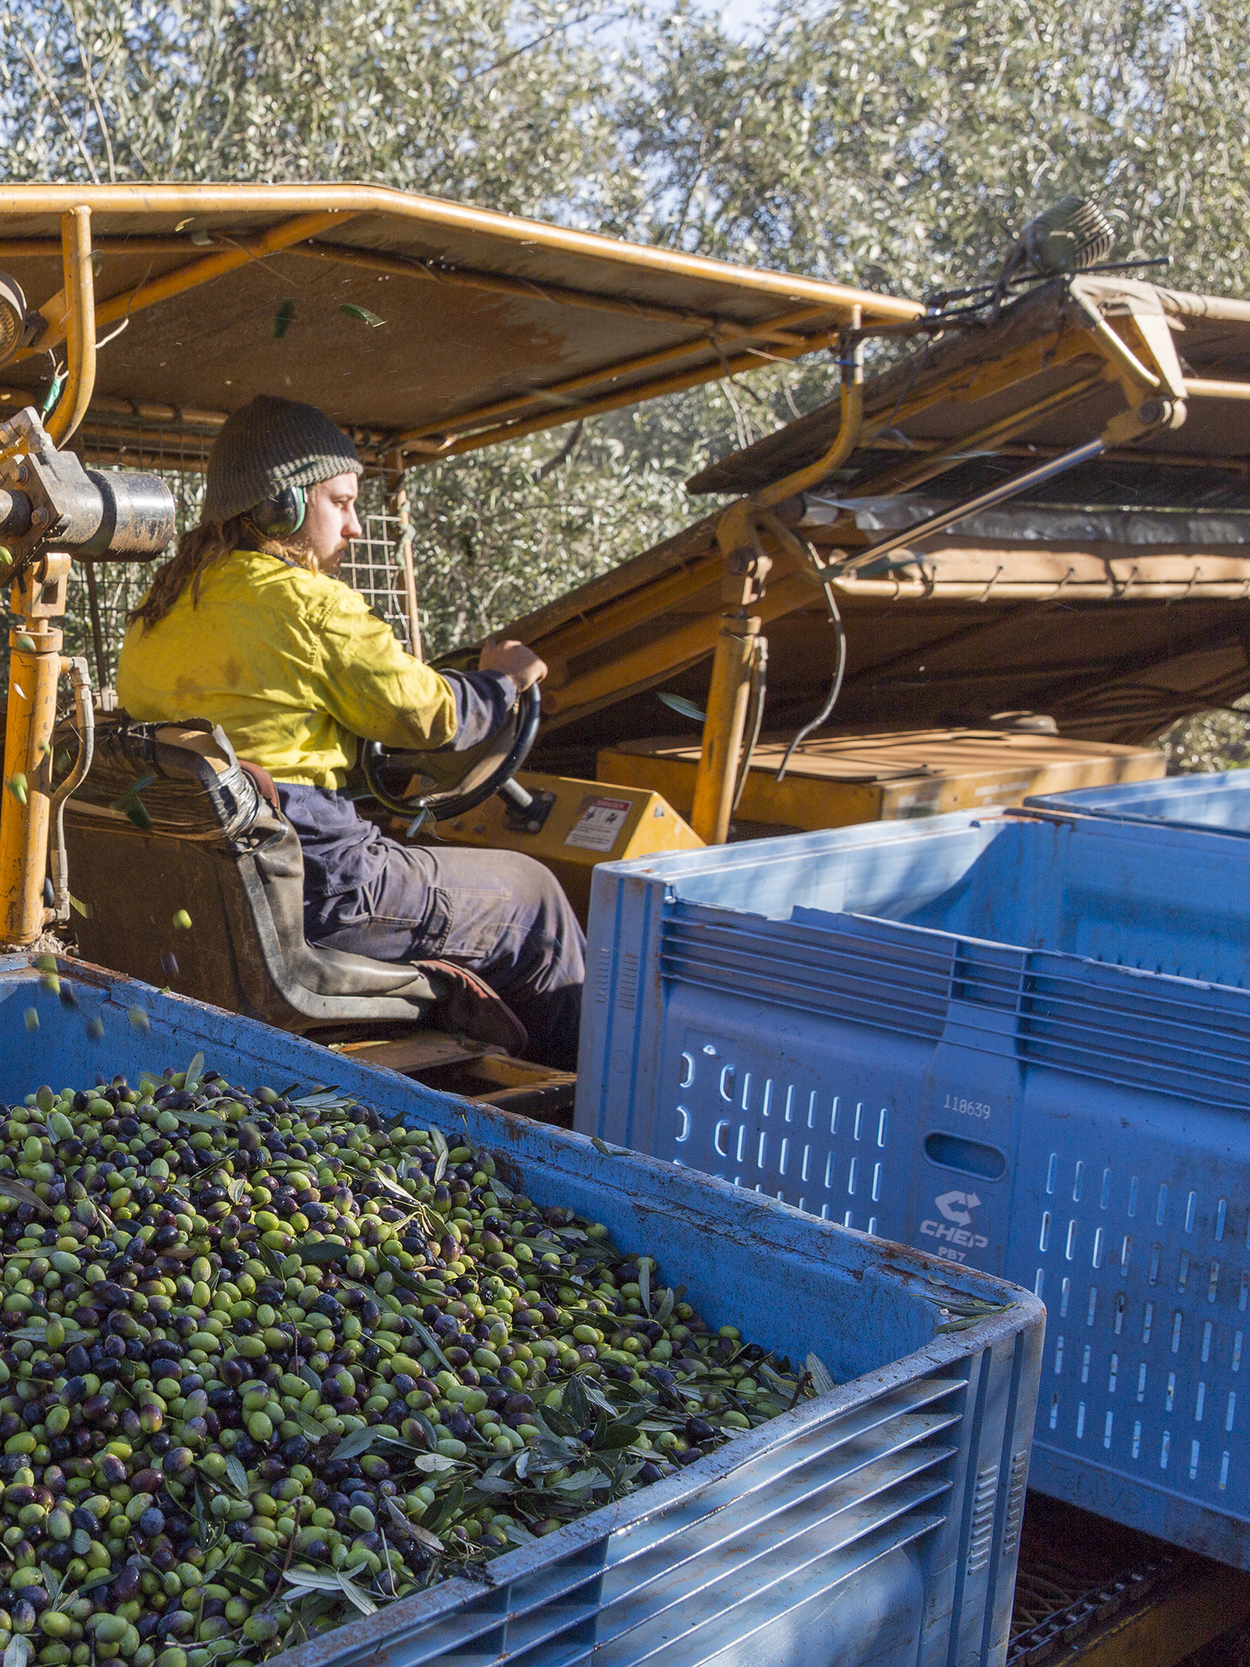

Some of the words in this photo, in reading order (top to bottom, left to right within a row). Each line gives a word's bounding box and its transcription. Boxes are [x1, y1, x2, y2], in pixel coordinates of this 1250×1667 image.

[944, 1095, 990, 1119] 118639
[919, 1219, 988, 1248] CHEP
[937, 1246, 966, 1263] PB7
